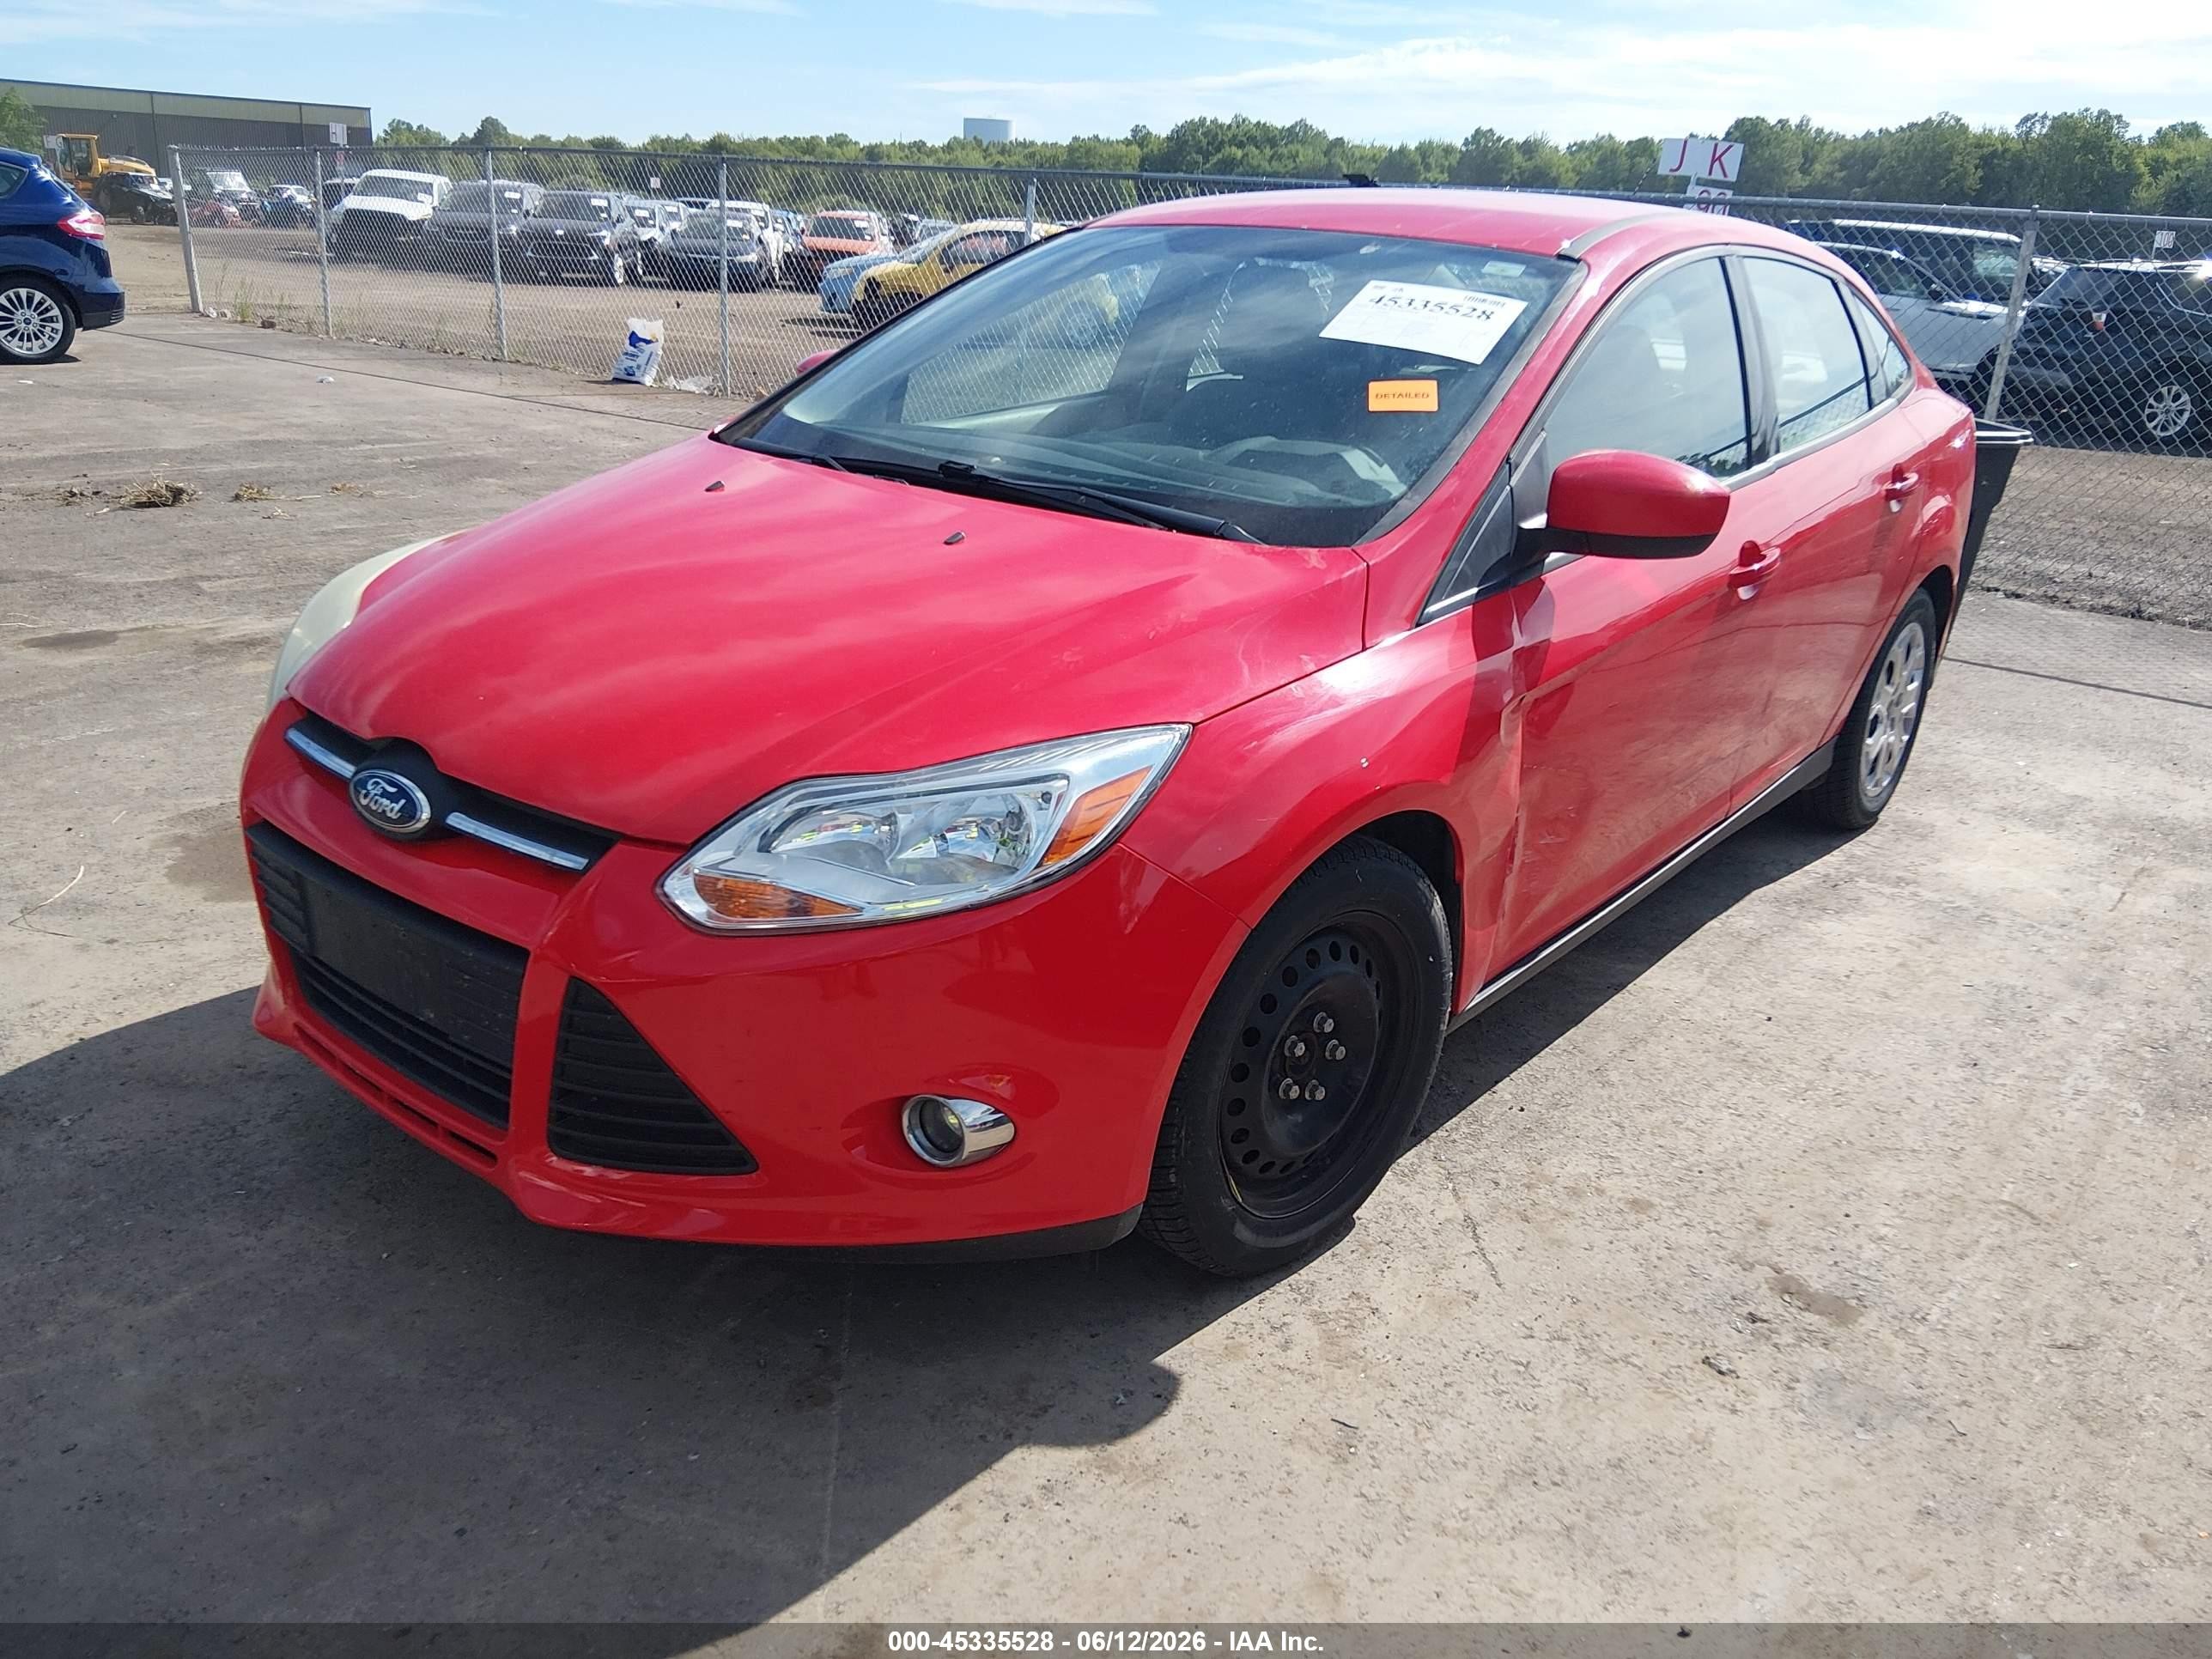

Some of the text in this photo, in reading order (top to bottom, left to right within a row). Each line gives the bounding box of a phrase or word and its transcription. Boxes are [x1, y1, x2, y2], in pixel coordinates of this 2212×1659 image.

[1668, 138, 1735, 179] J K
[1368, 295, 1495, 322] 45335528
[1375, 392, 1431, 400] DETAILED
[357, 777, 407, 820] Ford
